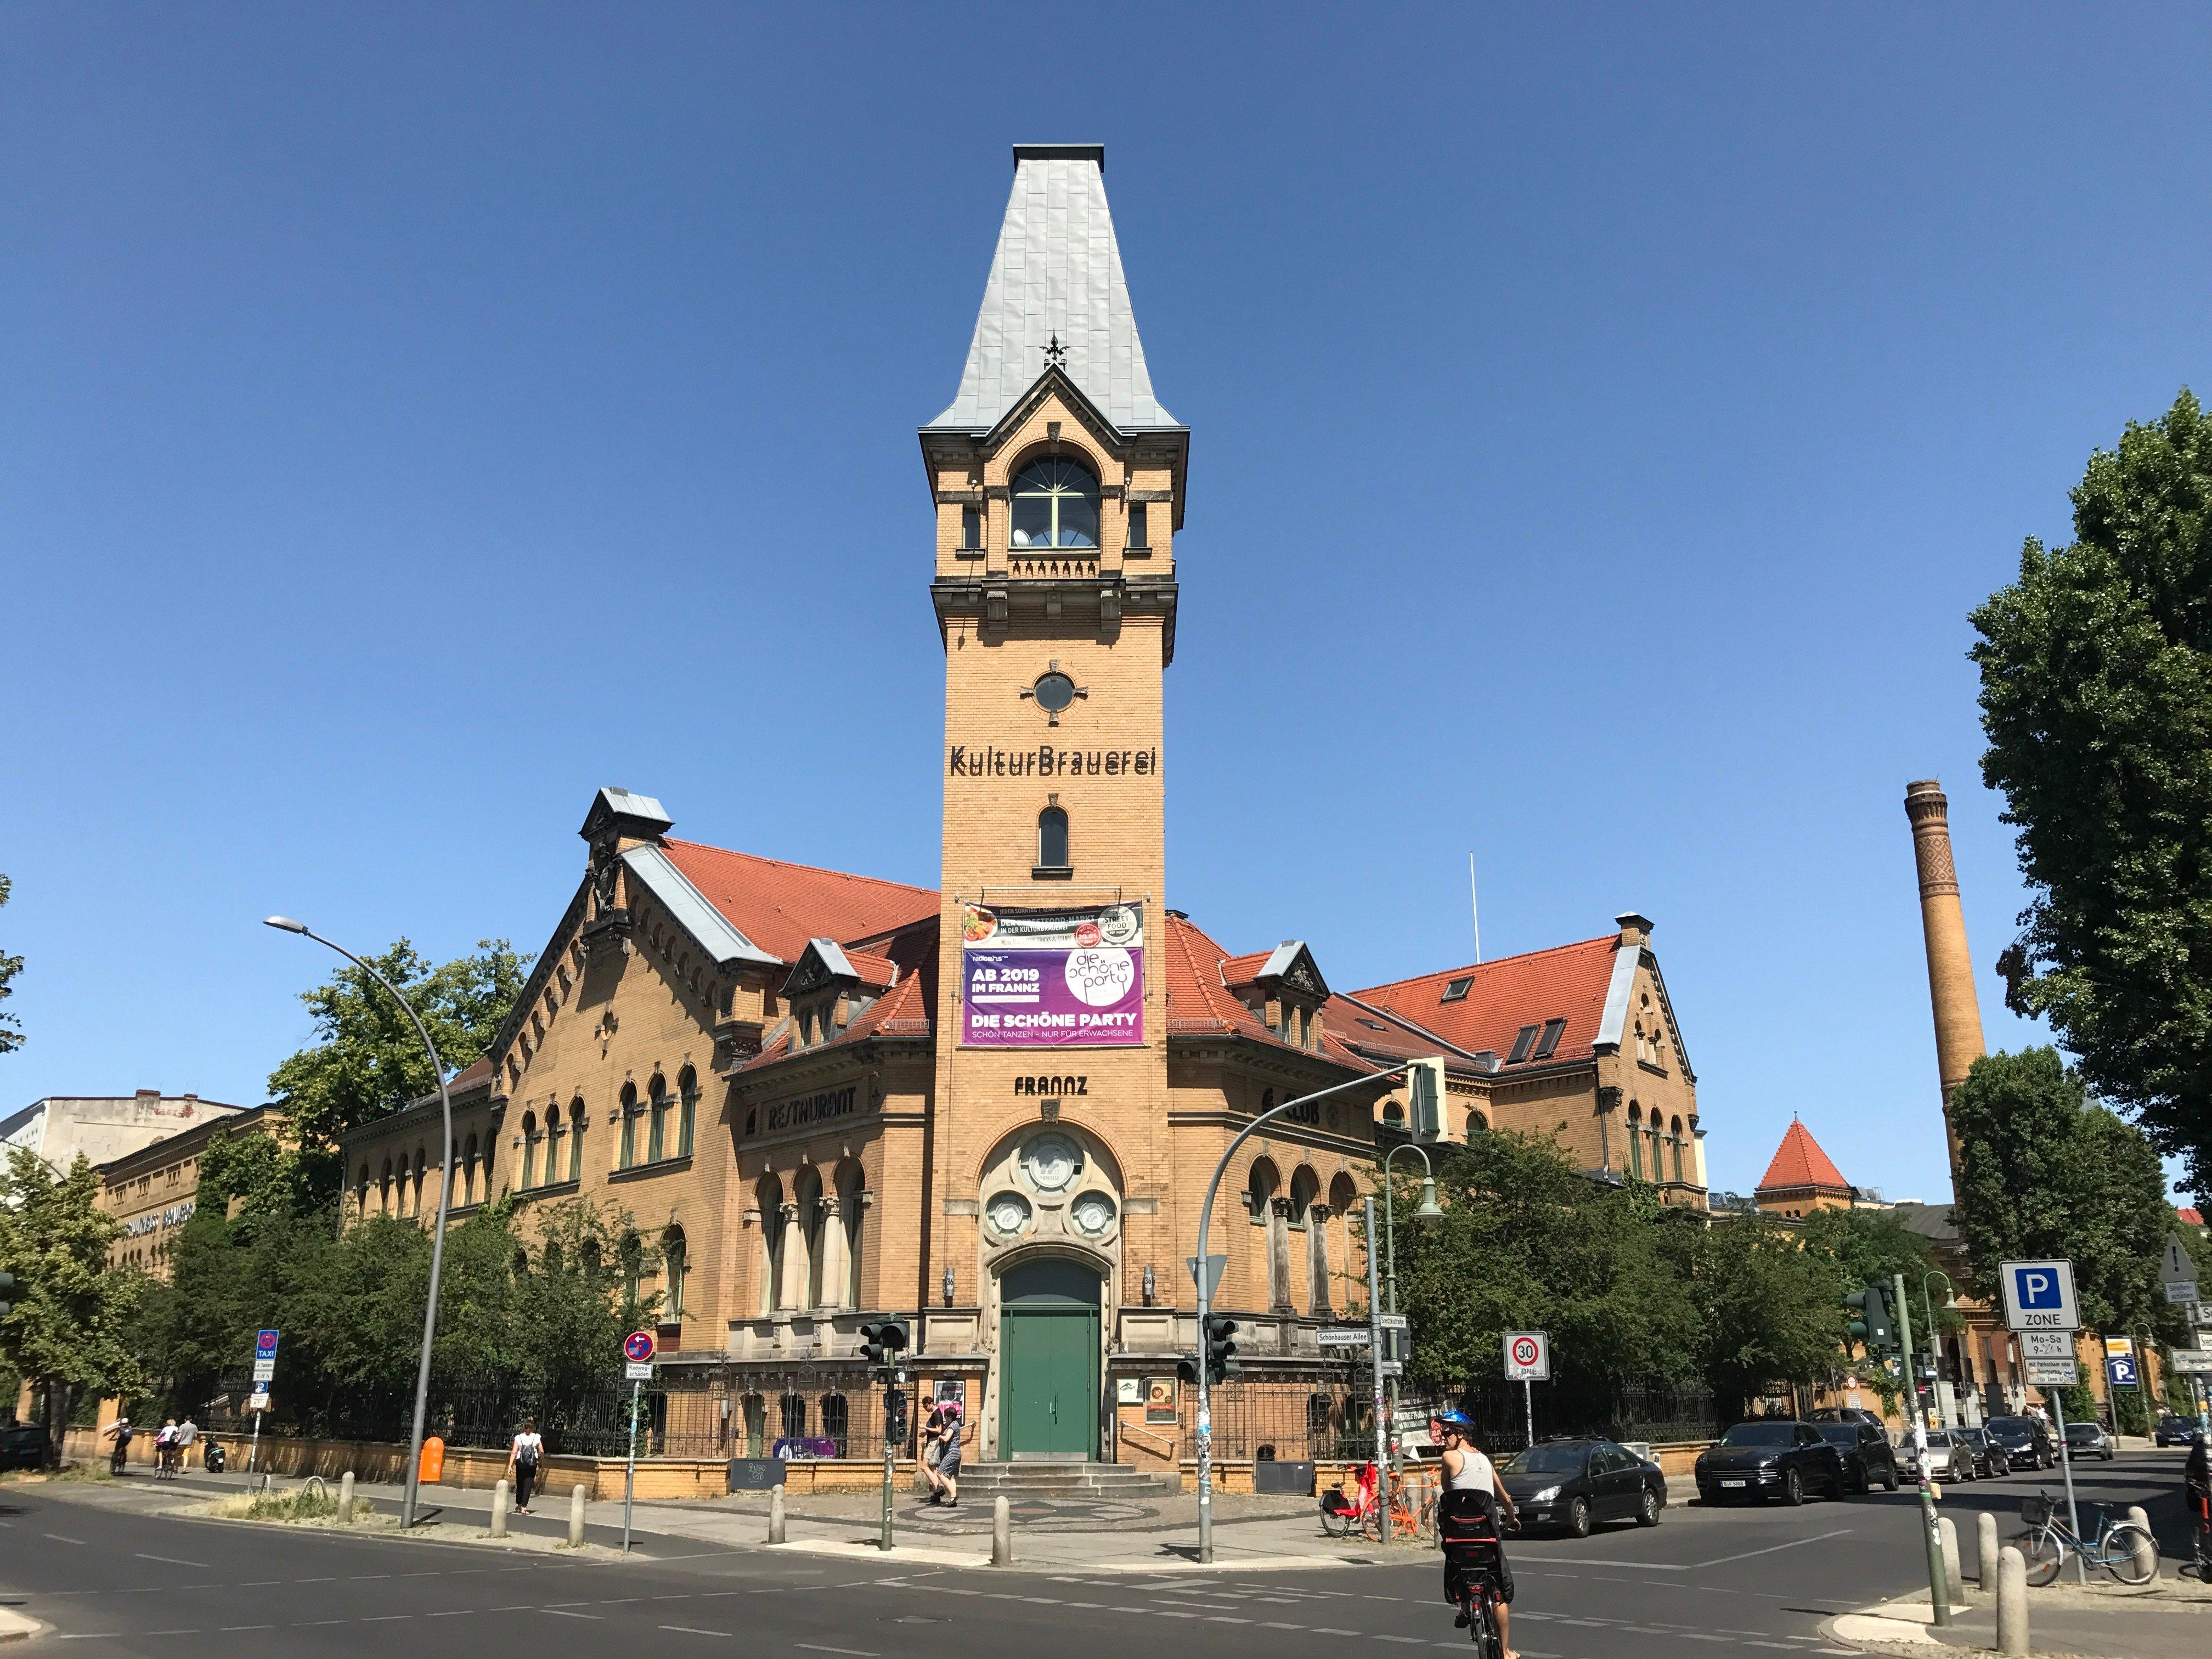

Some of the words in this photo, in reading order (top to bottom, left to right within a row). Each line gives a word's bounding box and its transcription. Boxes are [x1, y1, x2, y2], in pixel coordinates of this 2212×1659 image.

[951, 746, 1155, 776] KulturBrauerei
[972, 969, 997, 981] AB
[1000, 968, 1040, 981] 2019
[972, 984, 986, 992] IM
[988, 983, 1040, 992] FRANNZ
[1084, 970, 1127, 1004] party
[972, 1014, 1000, 1028] DIE
[1003, 1012, 1075, 1028] SCHÖNE
[1080, 1013, 1137, 1026] PARTY
[972, 1030, 1000, 1038] SCHÖN
[1015, 1076, 1087, 1096] FRANNZ
[769, 1086, 856, 1130] RESTAURANT
[946, 1277, 953, 1286] 36
[1144, 1277, 1152, 1285] 36
[2026, 1274, 2049, 1304] P
[2203, 1307, 2212, 1318] S
[2025, 1314, 2062, 1325] ZONE
[2030, 1335, 2062, 1343] Mo-Sa
[1518, 1345, 1533, 1358] 30
[2115, 1364, 2129, 1380] P
